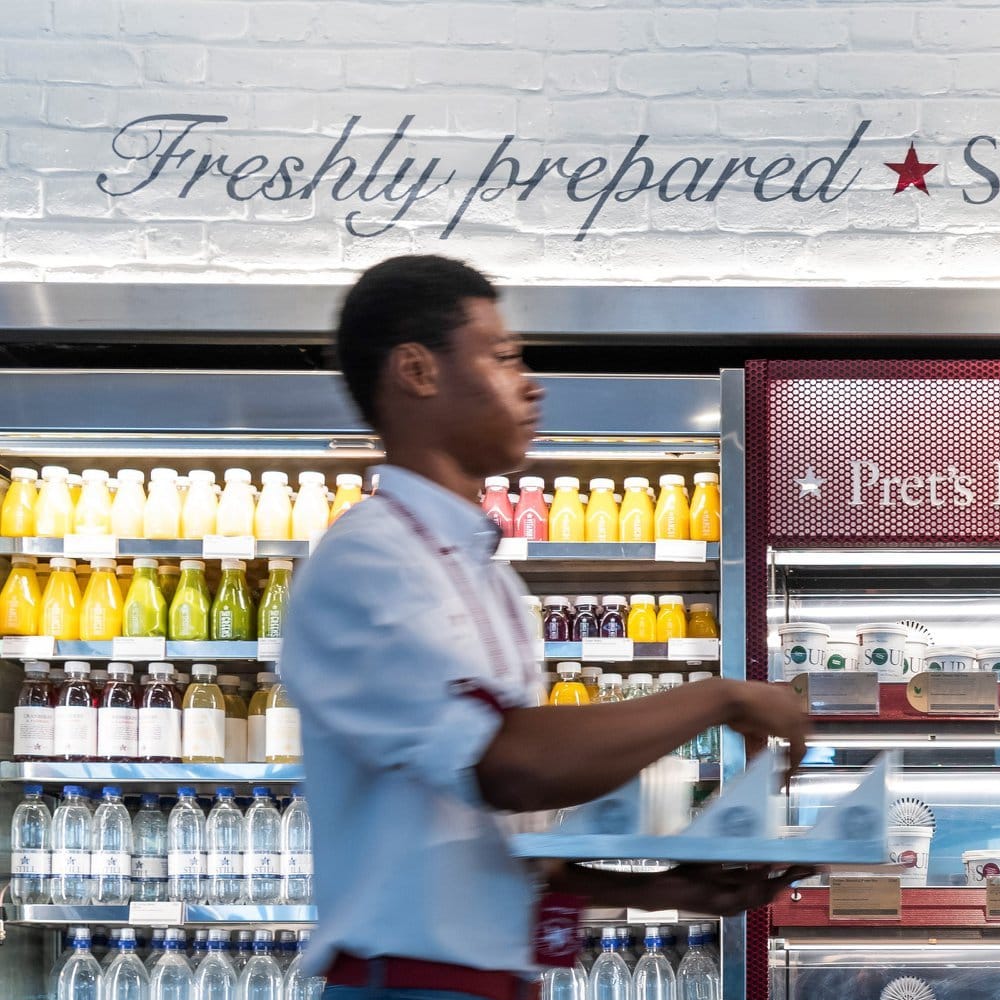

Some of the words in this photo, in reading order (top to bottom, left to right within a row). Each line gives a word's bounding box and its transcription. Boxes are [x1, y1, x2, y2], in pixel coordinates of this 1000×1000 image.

[96, 113, 456, 238] Freshly
[439, 119, 872, 242] prepared
[850, 459, 975, 506] Pret's
